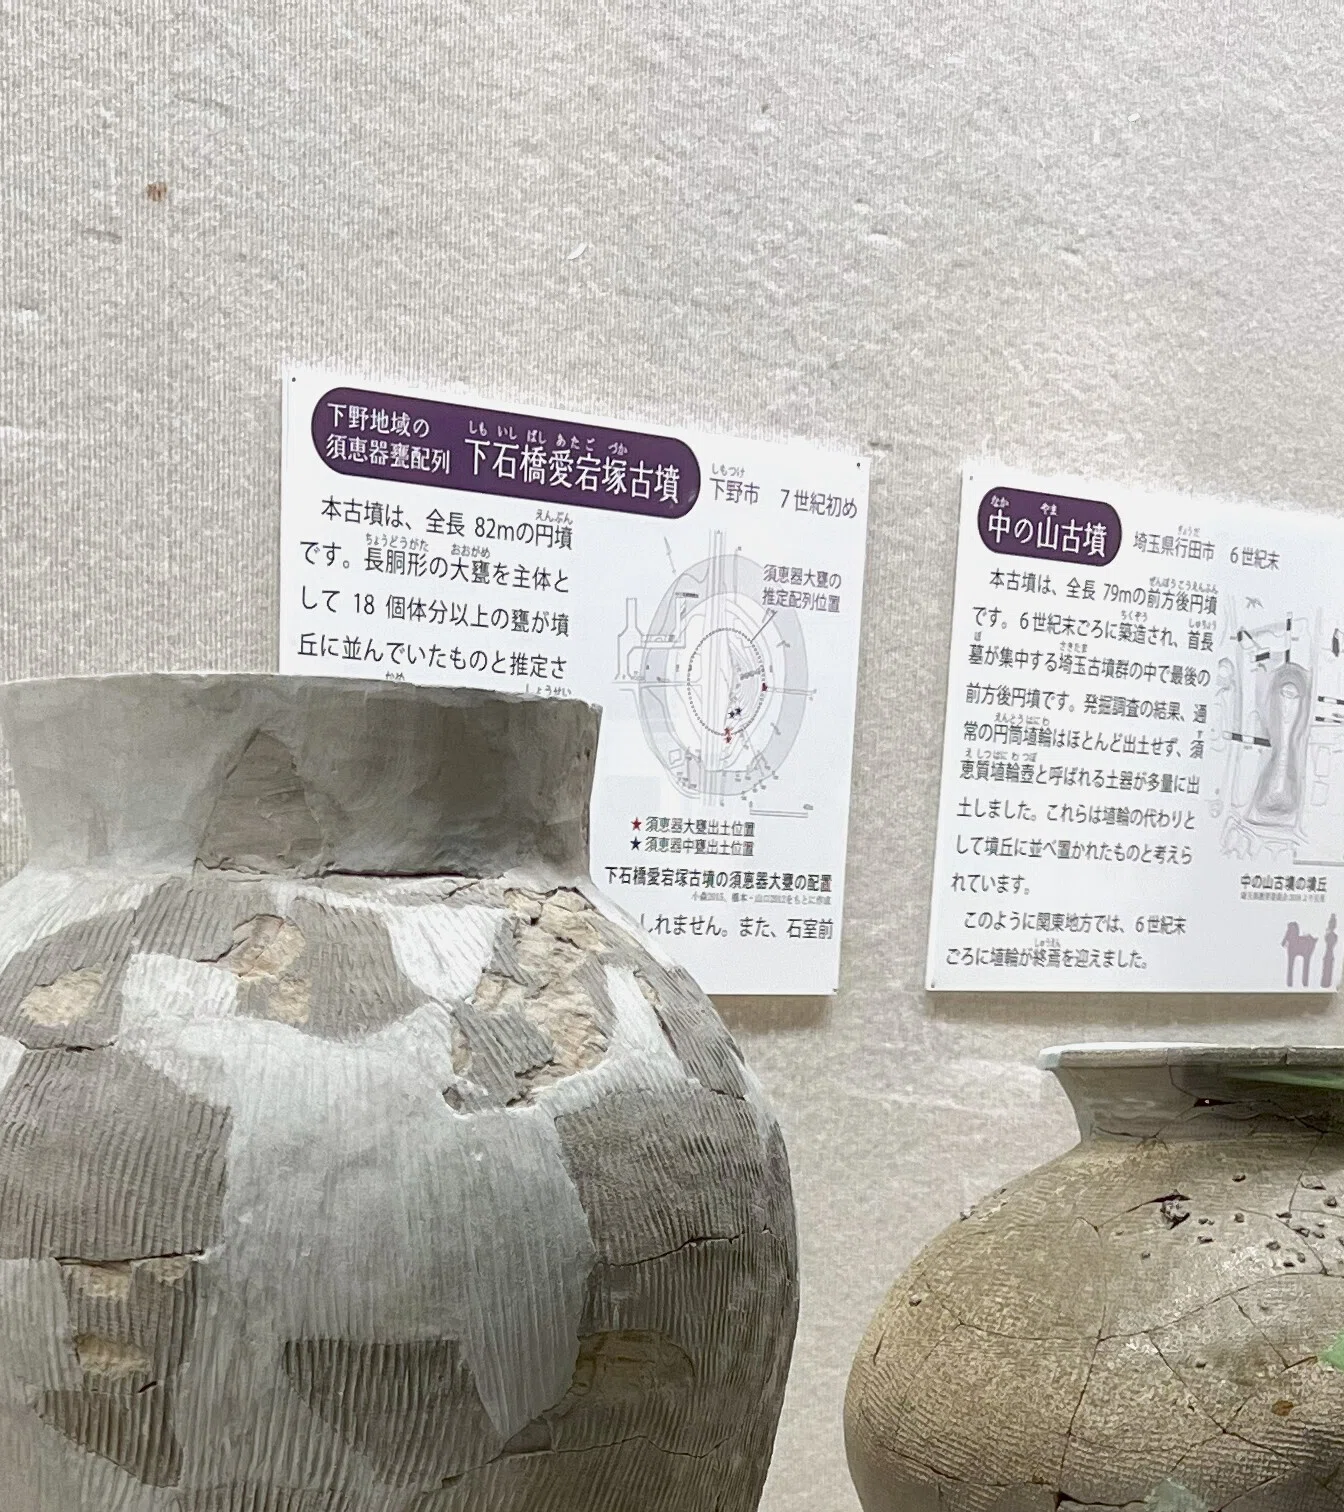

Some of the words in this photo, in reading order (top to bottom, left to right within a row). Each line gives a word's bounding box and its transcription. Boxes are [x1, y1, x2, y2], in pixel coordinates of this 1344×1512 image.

[327, 402, 430, 437] 下野地域の
[325, 433, 450, 475] 須恵器甕配列
[464, 437, 680, 505] 下石橋愛宕塚古墳
[709, 477, 761, 504] 下野市
[320, 495, 466, 538] 本古墳は、全長
[474, 517, 573, 550] 82mの円墳
[988, 509, 1107, 557] 中の山古墳
[1133, 531, 1215, 561] 埼玉県行田市
[1230, 547, 1280, 570] 6世紀末
[301, 585, 341, 613] して
[353, 593, 375, 615] 18
[385, 594, 570, 638] 個体分以上の甕が墳
[990, 568, 1096, 600] 本古墳は、全長
[1104, 583, 1217, 615] 79mの前方後円墳
[297, 632, 568, 680] 丘に並んでいたものと推定さ
[968, 643, 1210, 687] 墓が集中する埼玉古墳群の中で最後の
[957, 796, 1195, 830] 土しました。これらは埴輪の代わりと
[956, 834, 1193, 866] して墳丘に並べ置かれたものと考えら
[951, 873, 1030, 895] れています。
